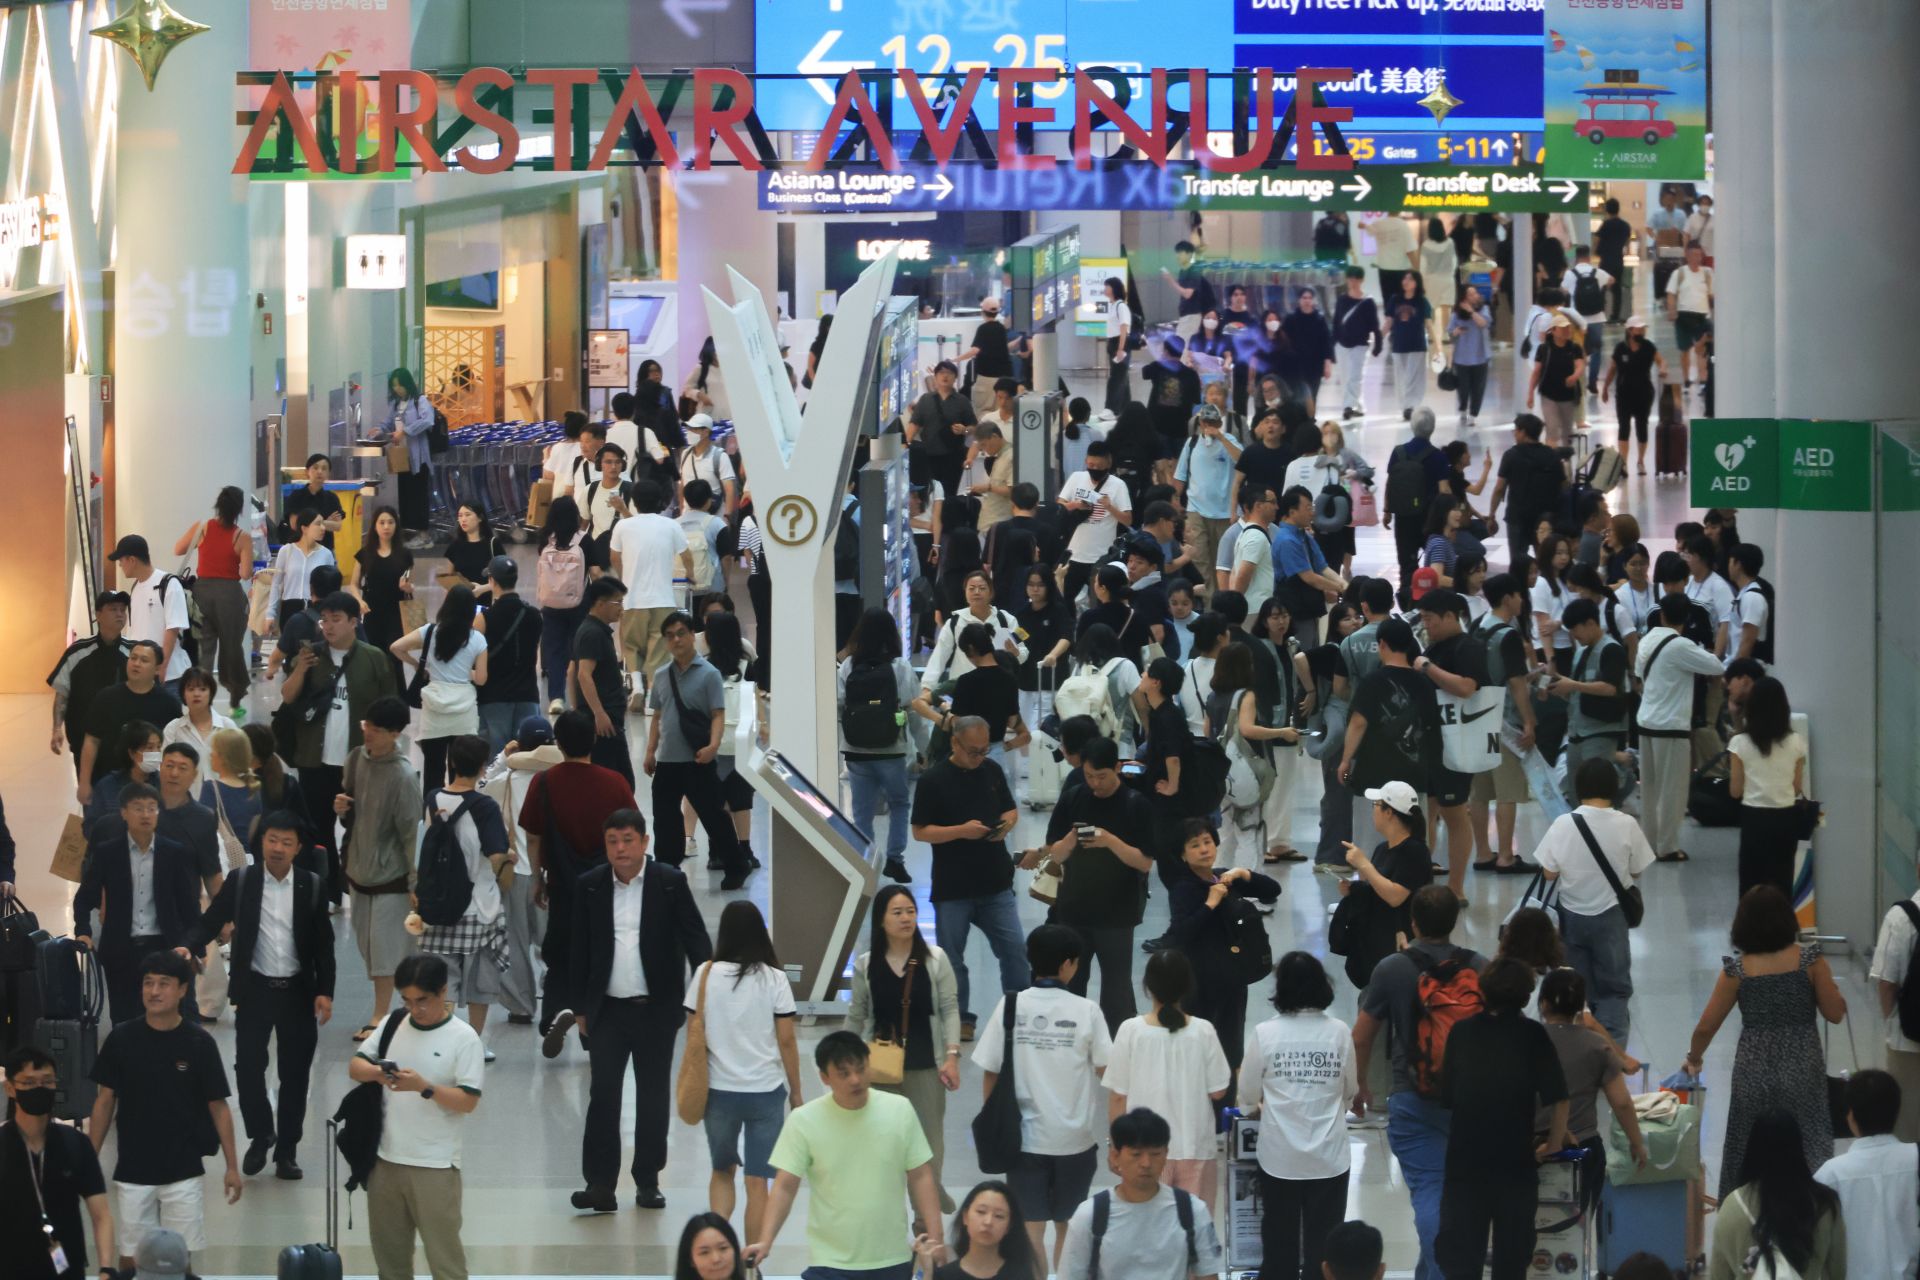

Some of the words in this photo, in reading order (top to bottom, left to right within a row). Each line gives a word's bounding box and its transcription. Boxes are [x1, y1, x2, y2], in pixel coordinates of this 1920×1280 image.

[231, 67, 767, 174] AIRSTAR
[804, 67, 1355, 172] AVENUE
[1382, 146, 1417, 159] Gates
[768, 171, 833, 190] Asiana
[839, 171, 916, 195] Lounge
[1184, 175, 1258, 197] Transfer
[1262, 175, 1334, 201] Lounge
[1403, 172, 1488, 192] Transfer
[1492, 172, 1541, 192] Desk
[768, 192, 812, 204] Business
[814, 192, 842, 204] Class
[1403, 194, 1443, 206] Asiana
[1445, 194, 1489, 207] Airlines
[1793, 447, 1834, 467] AED
[1710, 476, 1751, 491] AED
